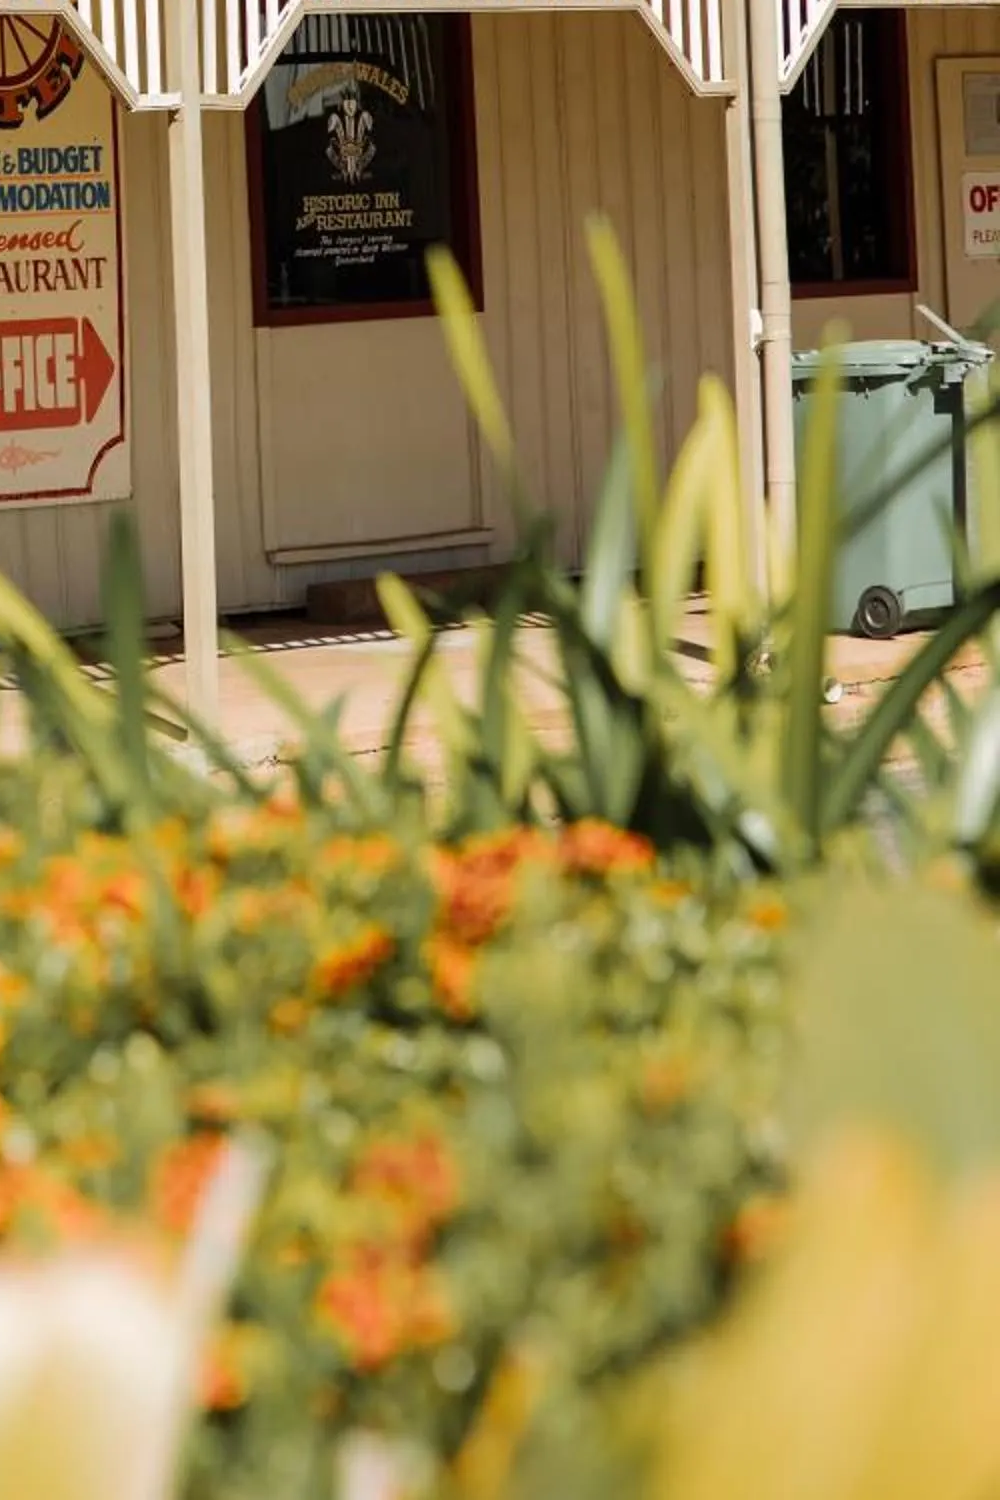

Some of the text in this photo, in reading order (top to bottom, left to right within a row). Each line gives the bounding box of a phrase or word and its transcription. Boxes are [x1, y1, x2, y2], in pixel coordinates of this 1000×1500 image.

[17, 146, 103, 174] BUDGET
[302, 192, 400, 213] HISTORIC INN
[316, 209, 413, 231] RESTAURANT
